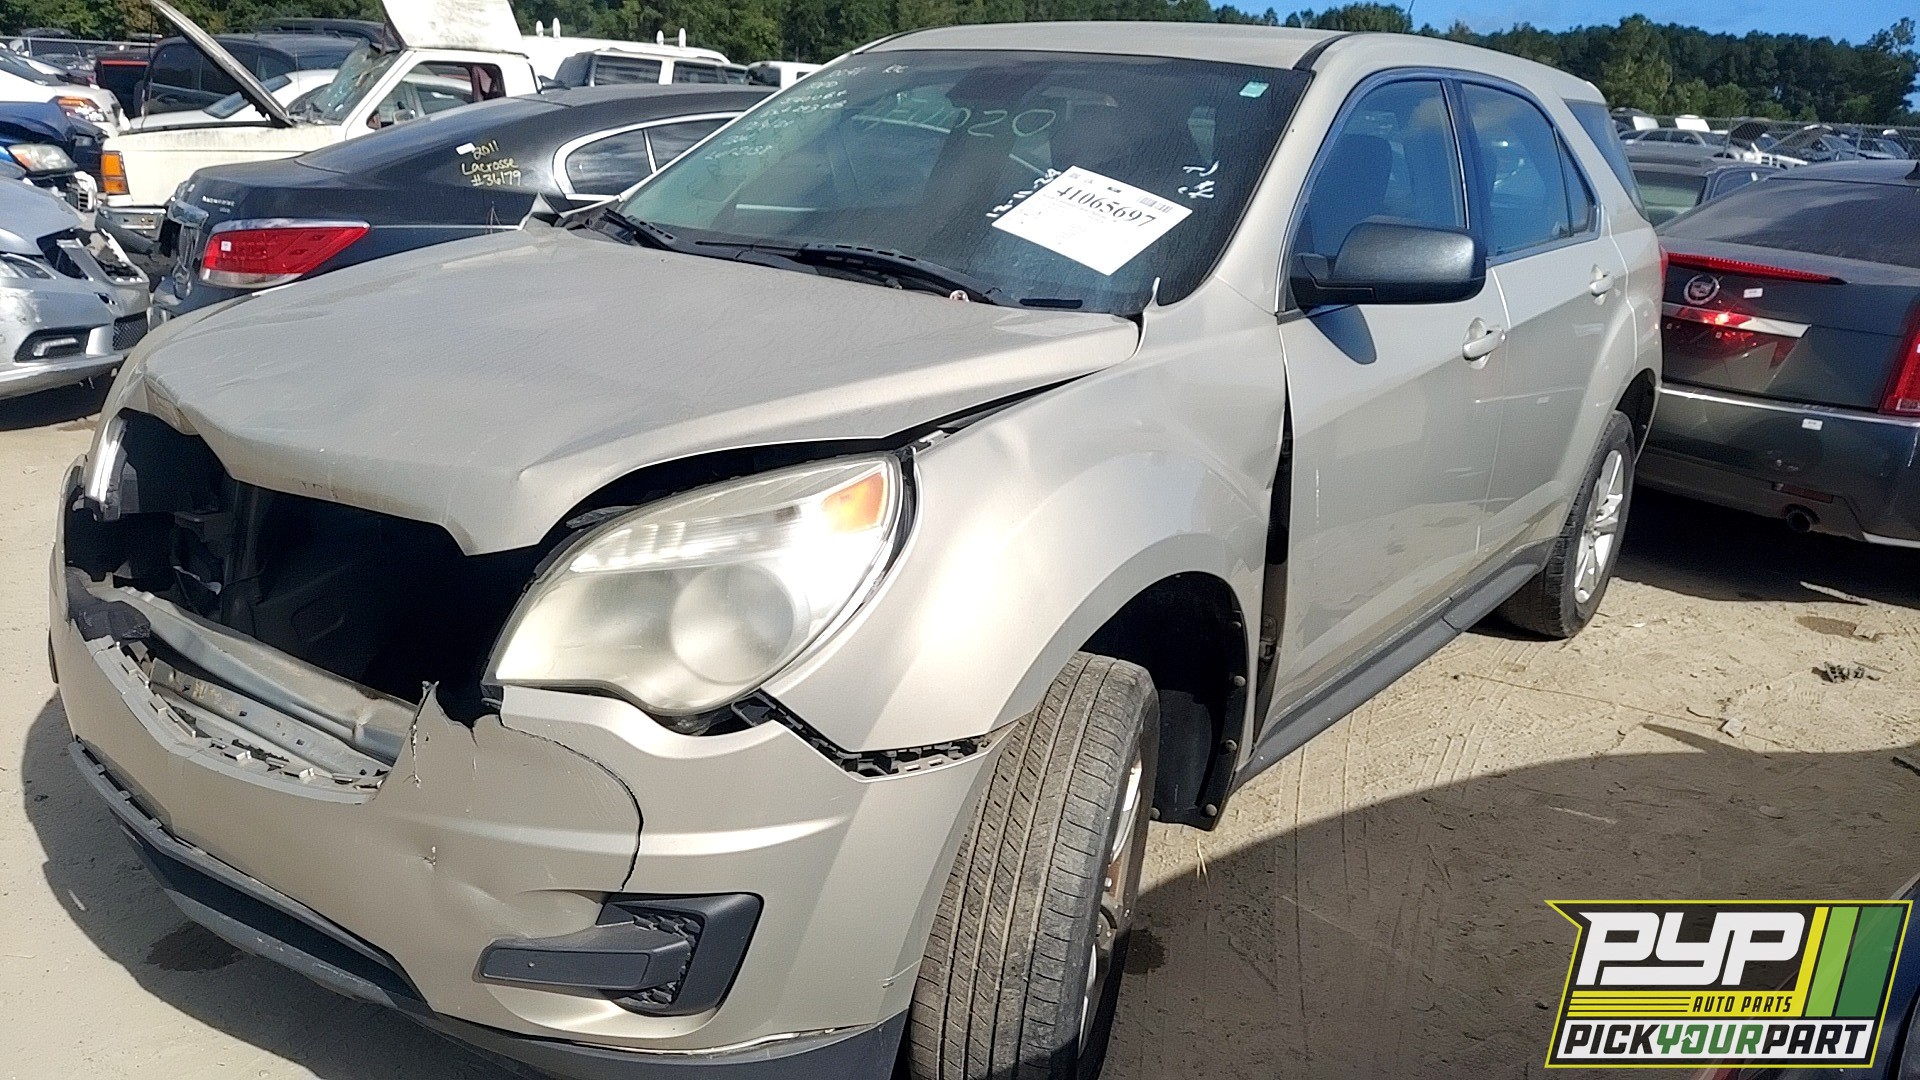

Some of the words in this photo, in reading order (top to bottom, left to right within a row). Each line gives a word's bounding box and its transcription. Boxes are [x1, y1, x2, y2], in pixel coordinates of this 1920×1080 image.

[472, 139, 499, 160] 2011
[470, 170, 522, 187] #36179
[1056, 185, 1158, 228] 41065697
